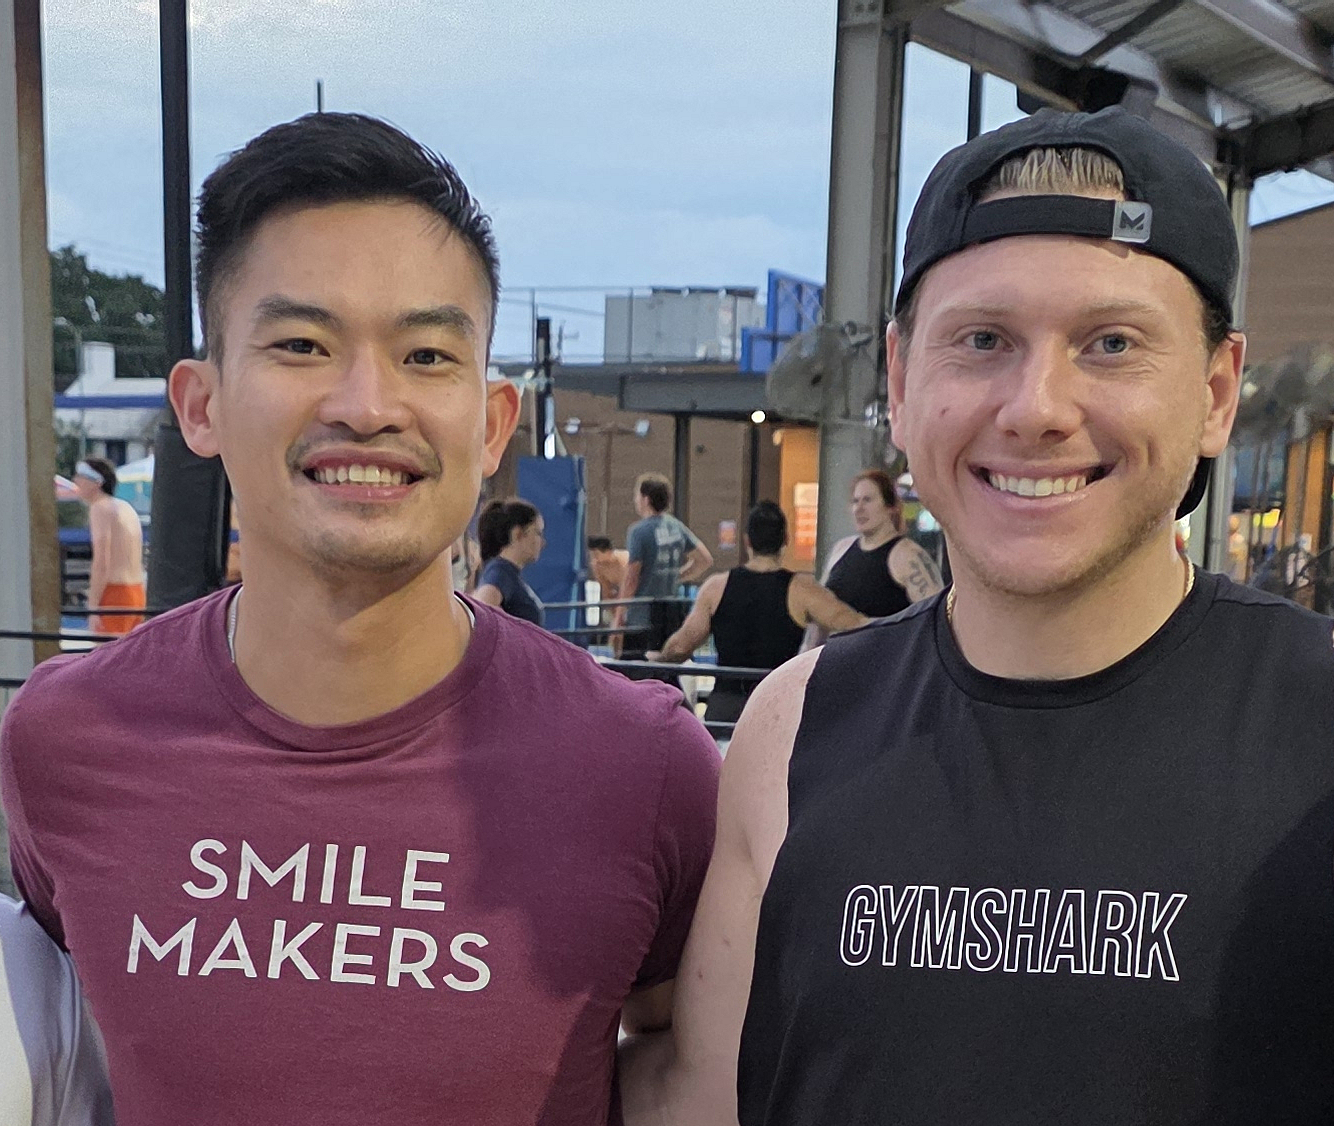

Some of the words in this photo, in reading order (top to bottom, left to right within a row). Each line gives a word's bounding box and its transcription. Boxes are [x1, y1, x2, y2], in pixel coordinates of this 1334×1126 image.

[181, 838, 450, 912] SMILE
[127, 913, 491, 992] MAKERS
[839, 884, 1188, 981] GYMSHARK
